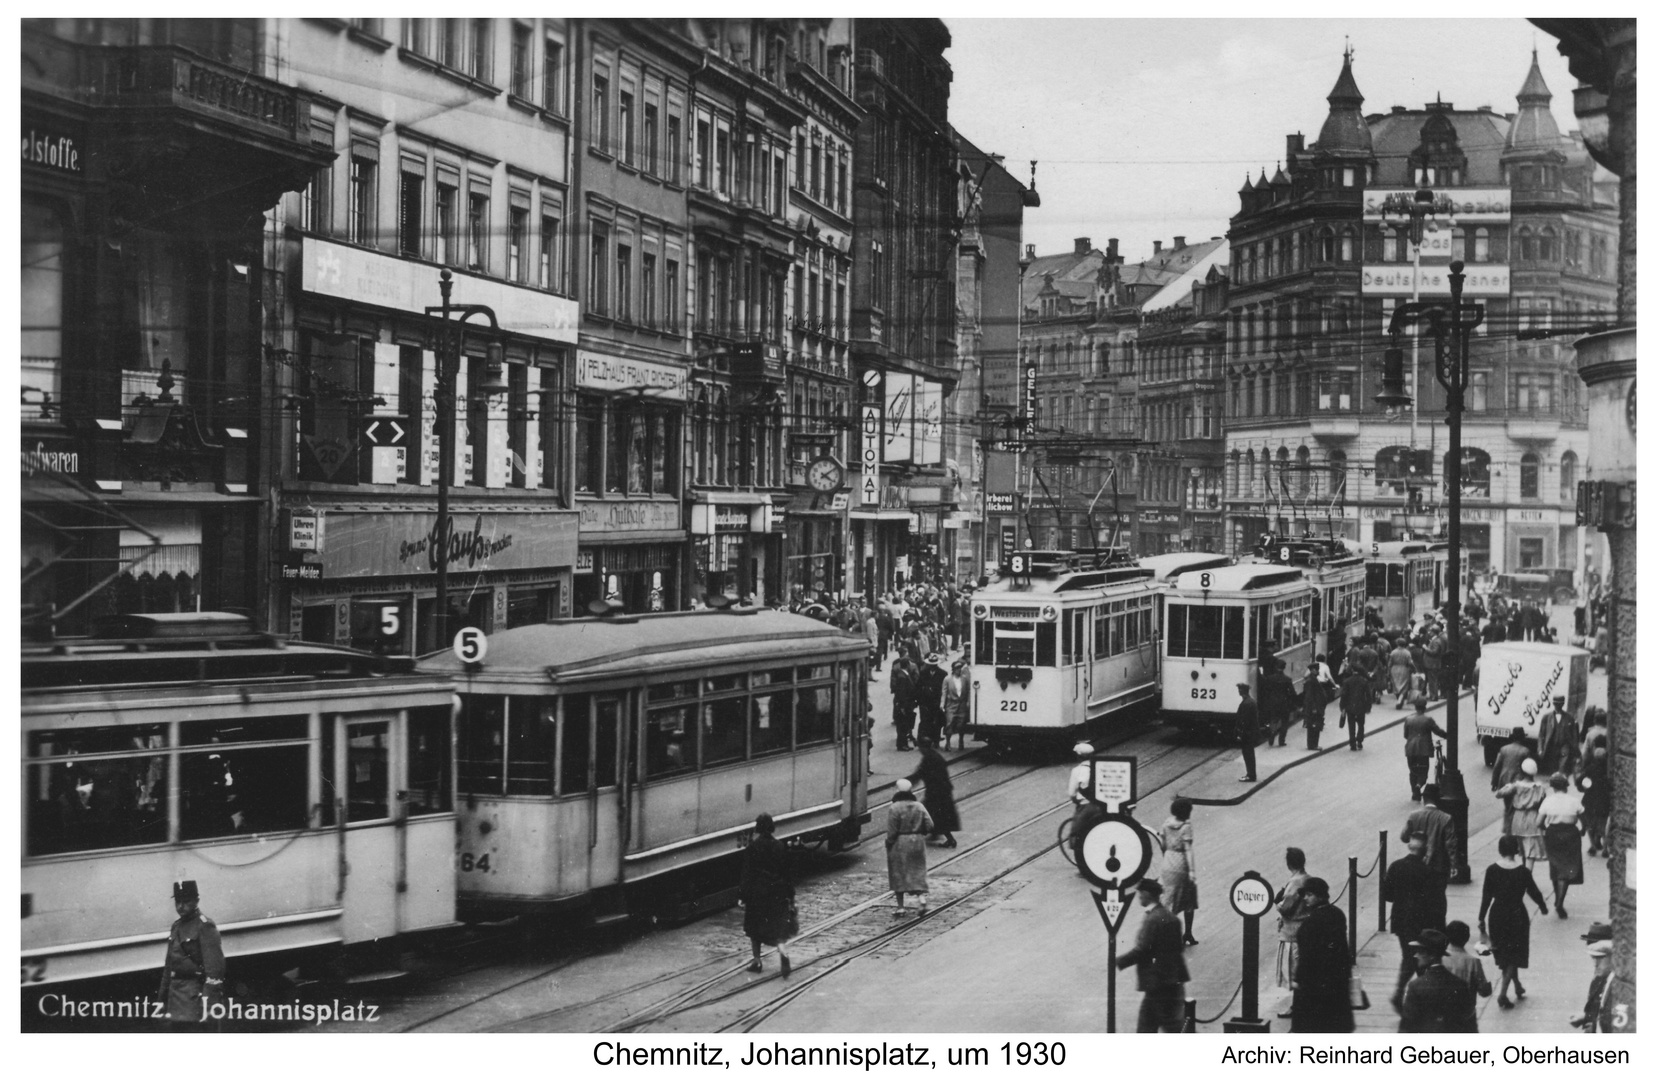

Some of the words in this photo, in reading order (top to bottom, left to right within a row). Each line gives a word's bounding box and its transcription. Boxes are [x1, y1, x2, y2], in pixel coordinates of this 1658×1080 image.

[1363, 272, 1441, 286] Deutshe
[588, 359, 625, 383] PELZHAUS
[627, 366, 649, 384] FRANZ
[865, 409, 877, 503] AUTOMAT
[986, 493, 1012, 503] rberei
[986, 502, 1013, 511] lichow
[294, 519, 314, 529] Uhren
[294, 531, 313, 541] Klinik
[1263, 535, 1271, 546] 7
[1280, 546, 1290, 561] 8
[1371, 543, 1379, 553] 5
[1011, 556, 1024, 573] 8
[1200, 572, 1210, 588] 8
[992, 609, 1040, 618] Weststrasse
[382, 606, 399, 635] 5
[462, 632, 479, 659] 5
[1191, 688, 1217, 700] 623
[1488, 662, 1522, 715] Jacobs
[1000, 700, 1028, 713] 220
[456, 852, 491, 873] 64
[1236, 890, 1266, 903] Papier
